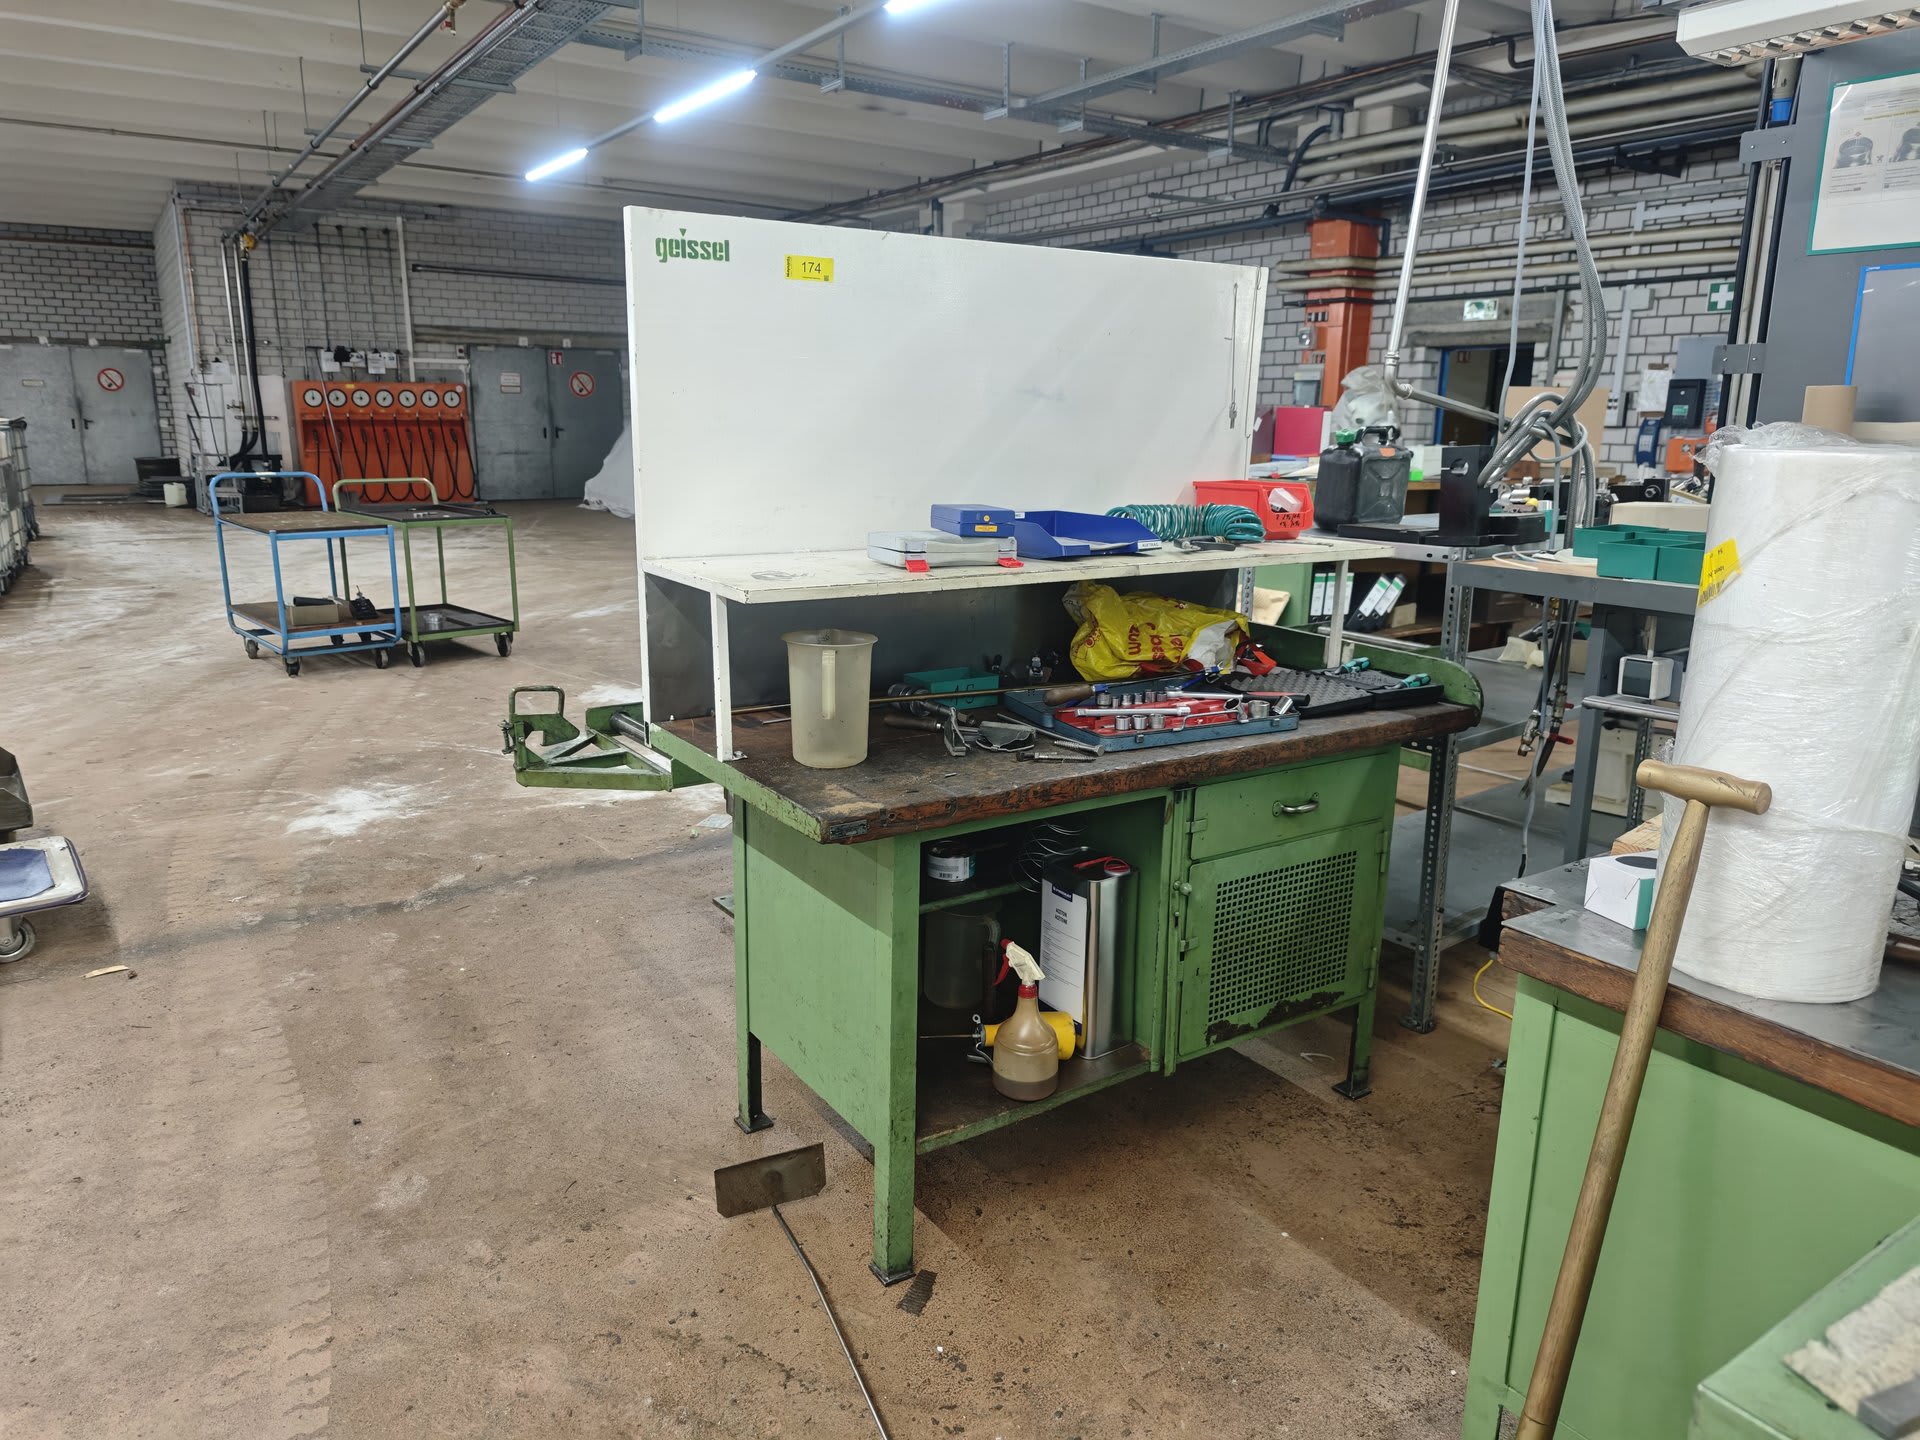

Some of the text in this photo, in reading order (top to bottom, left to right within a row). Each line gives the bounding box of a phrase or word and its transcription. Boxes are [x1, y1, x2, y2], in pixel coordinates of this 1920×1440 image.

[655, 228, 730, 263] geissel
[801, 261, 822, 274] 174
[1128, 623, 1142, 655] zum
